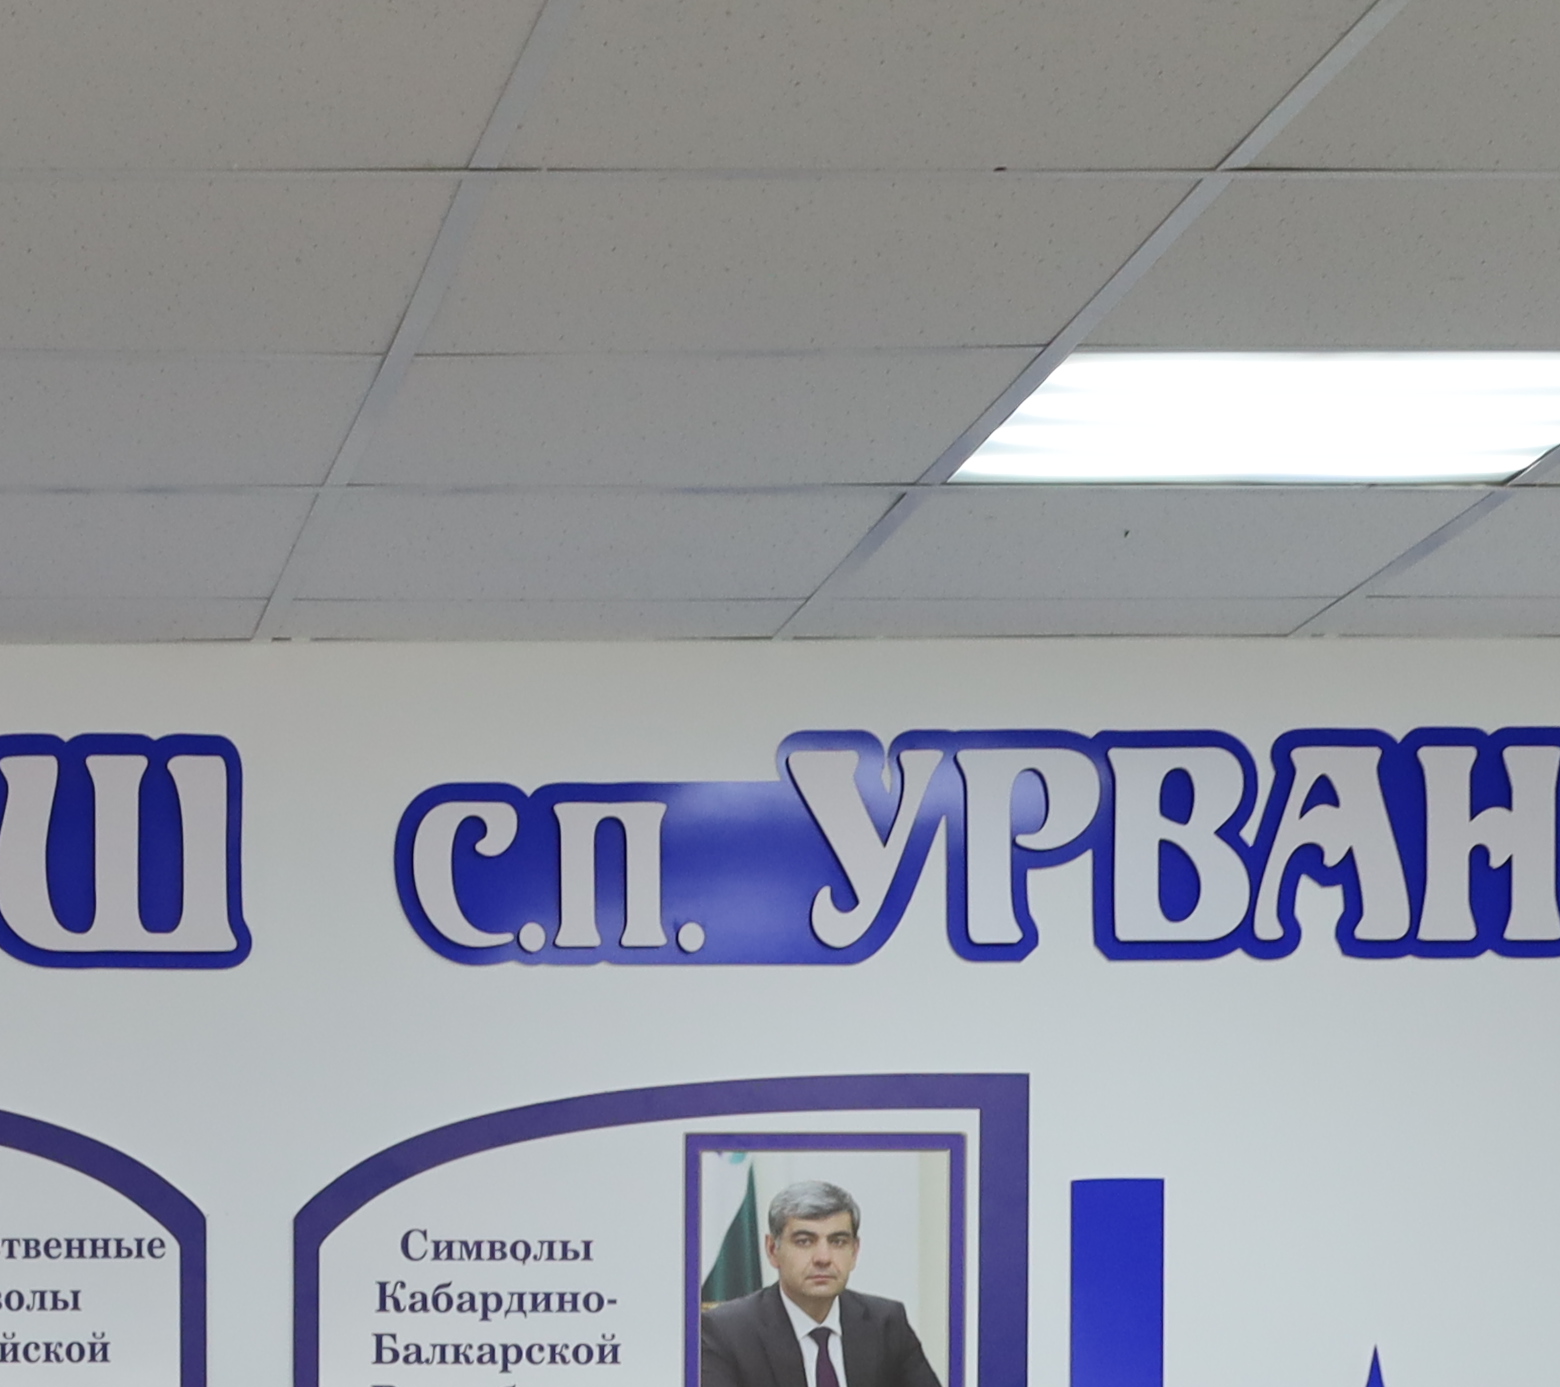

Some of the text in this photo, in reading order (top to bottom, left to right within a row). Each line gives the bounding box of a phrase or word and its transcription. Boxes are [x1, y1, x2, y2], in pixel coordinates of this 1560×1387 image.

[400, 1228, 594, 1265] Символы
[375, 1281, 618, 1321] Кабардино-
[371, 1333, 622, 1373] Балкарской
